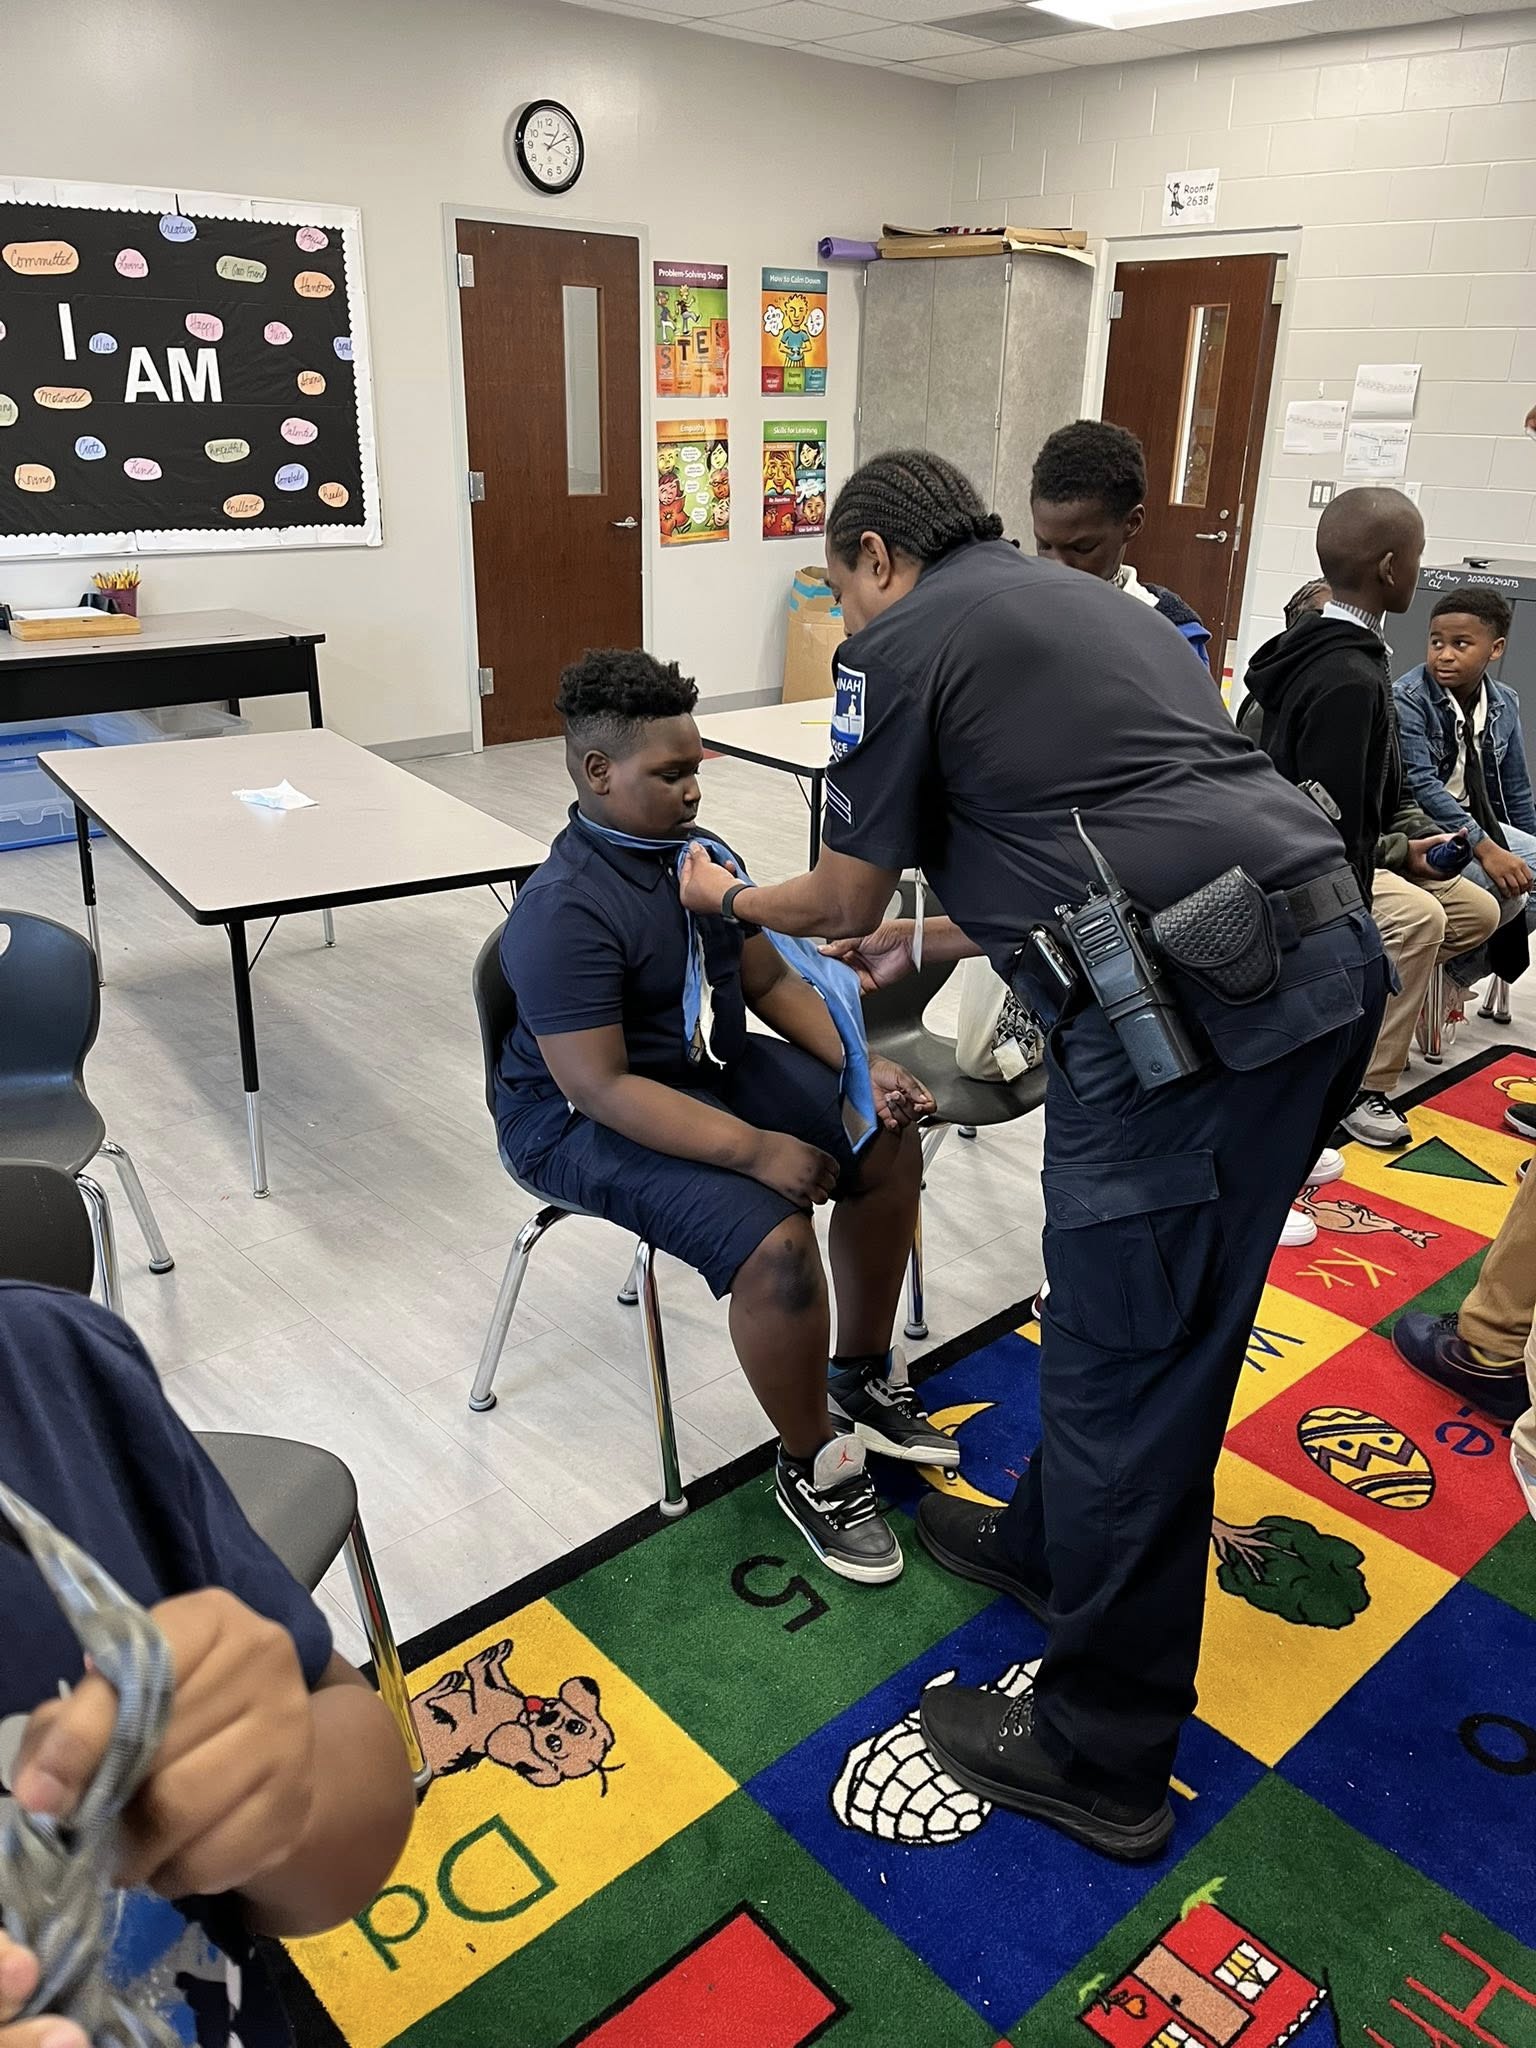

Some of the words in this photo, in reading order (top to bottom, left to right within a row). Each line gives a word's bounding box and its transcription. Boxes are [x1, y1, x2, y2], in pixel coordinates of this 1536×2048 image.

[528, 140, 533, 149] 9
[565, 145, 571, 154] 3
[547, 168, 553, 176] 6
[1187, 195, 1209, 206] 2638
[10, 249, 73, 268] Committed
[658, 268, 707, 281] Problem-Solving
[58, 303, 77, 361] I
[124, 346, 223, 403] AM
[731, 1553, 830, 1634] 5
